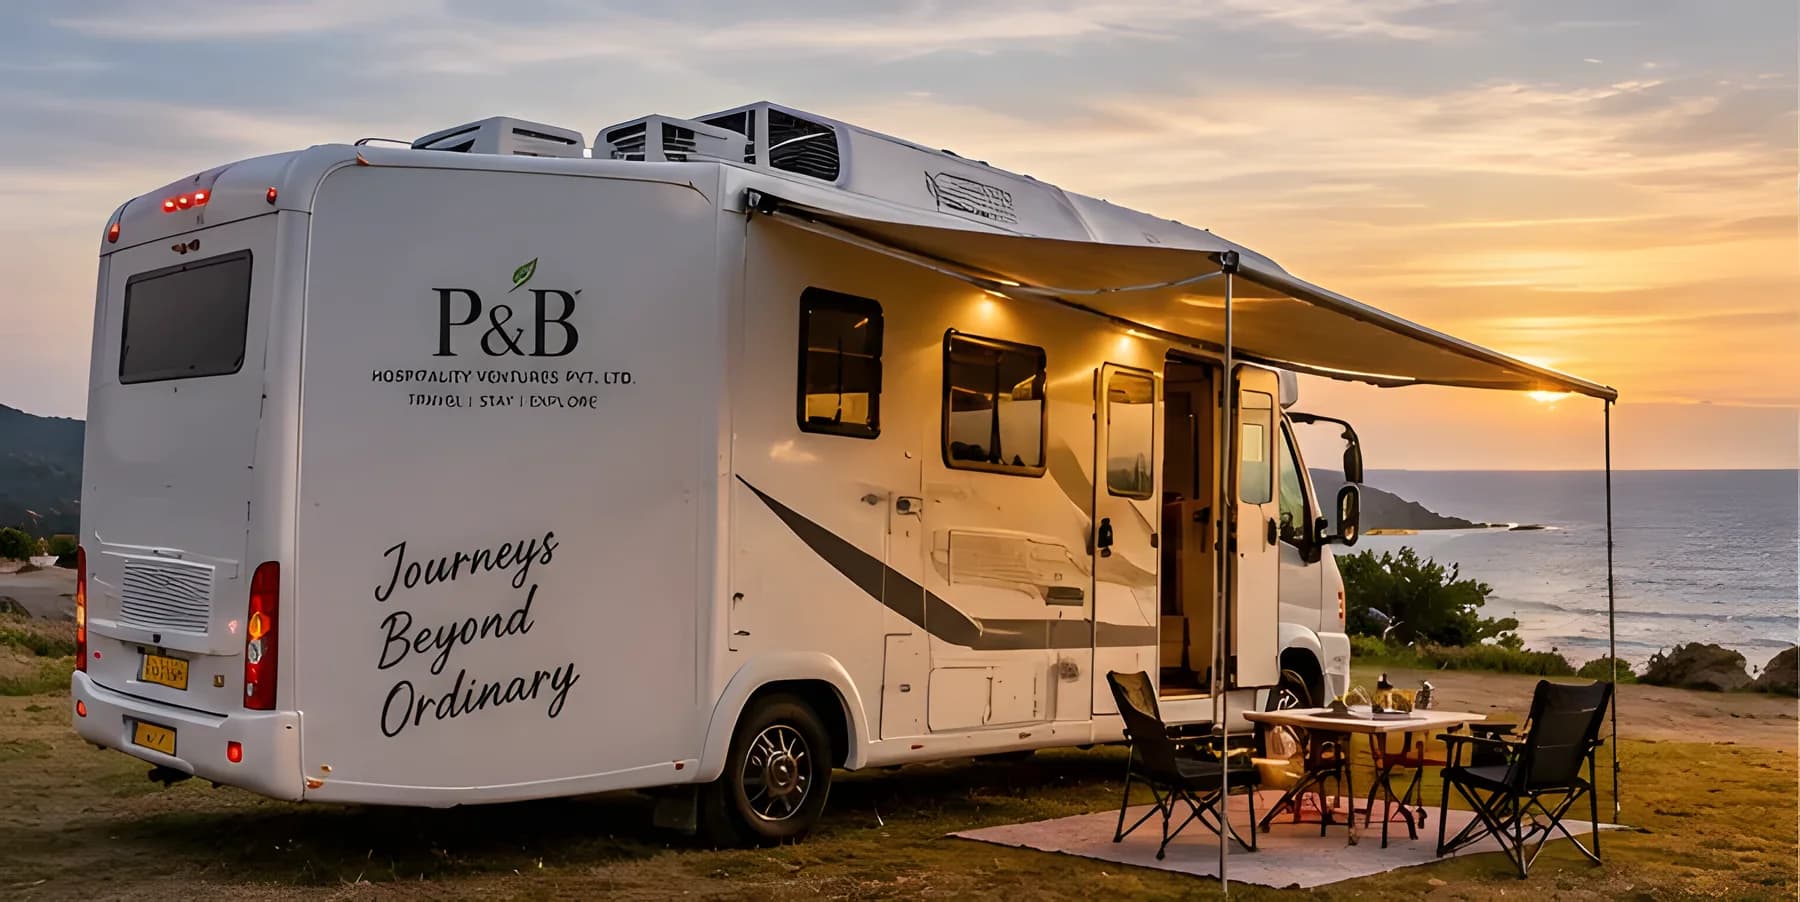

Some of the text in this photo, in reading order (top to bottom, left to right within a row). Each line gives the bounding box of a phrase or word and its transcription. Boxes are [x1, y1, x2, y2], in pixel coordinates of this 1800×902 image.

[431, 287, 579, 357] P&B
[479, 395, 515, 408] STAY
[603, 371, 637, 385] LTD.
[374, 530, 560, 603] Journeys
[377, 583, 540, 676] Beyond
[380, 662, 581, 738] Ordinary
